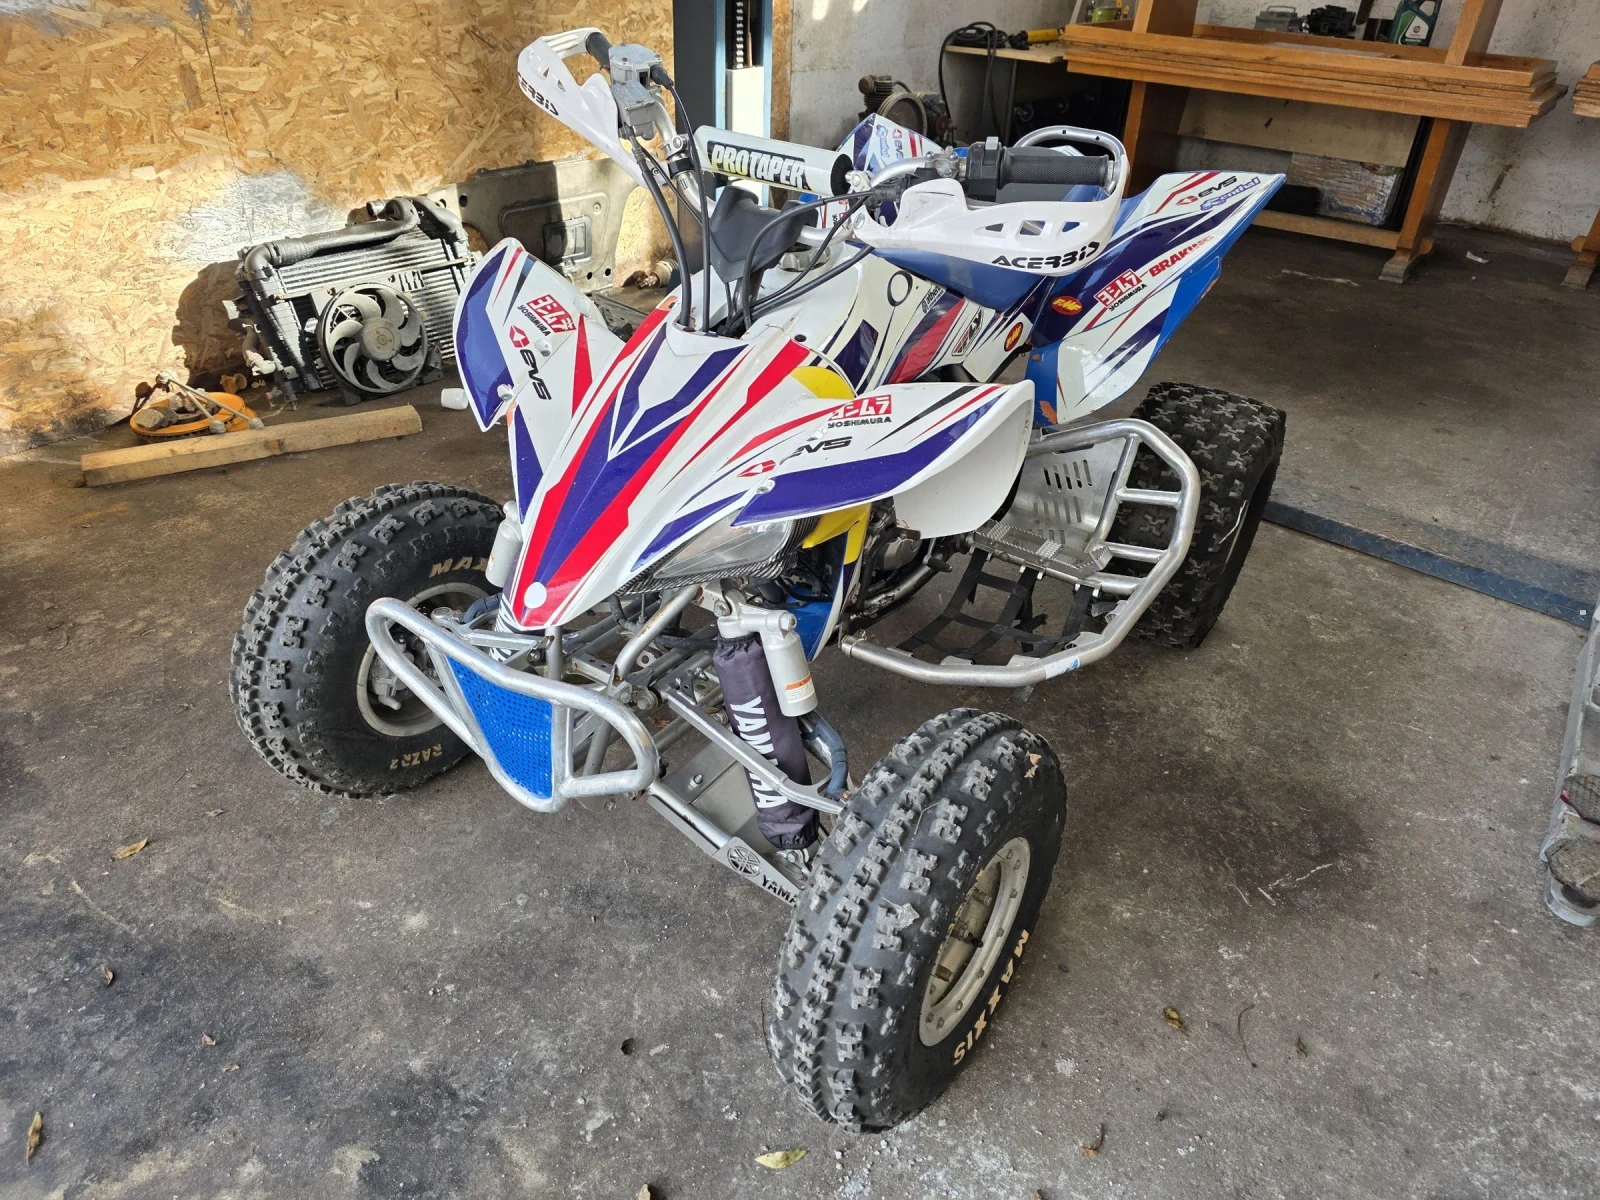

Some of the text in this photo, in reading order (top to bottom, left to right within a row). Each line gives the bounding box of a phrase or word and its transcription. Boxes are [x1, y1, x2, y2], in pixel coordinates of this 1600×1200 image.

[711, 144, 806, 189] PROTAPER
[1198, 175, 1238, 198] EVS
[1108, 283, 1148, 312] YOSHIMURA
[517, 304, 551, 336] YOSHIMURA
[519, 348, 552, 400] EVS
[827, 416, 892, 429] YOSHIMURA
[953, 929, 1030, 1066] MAXXIS
